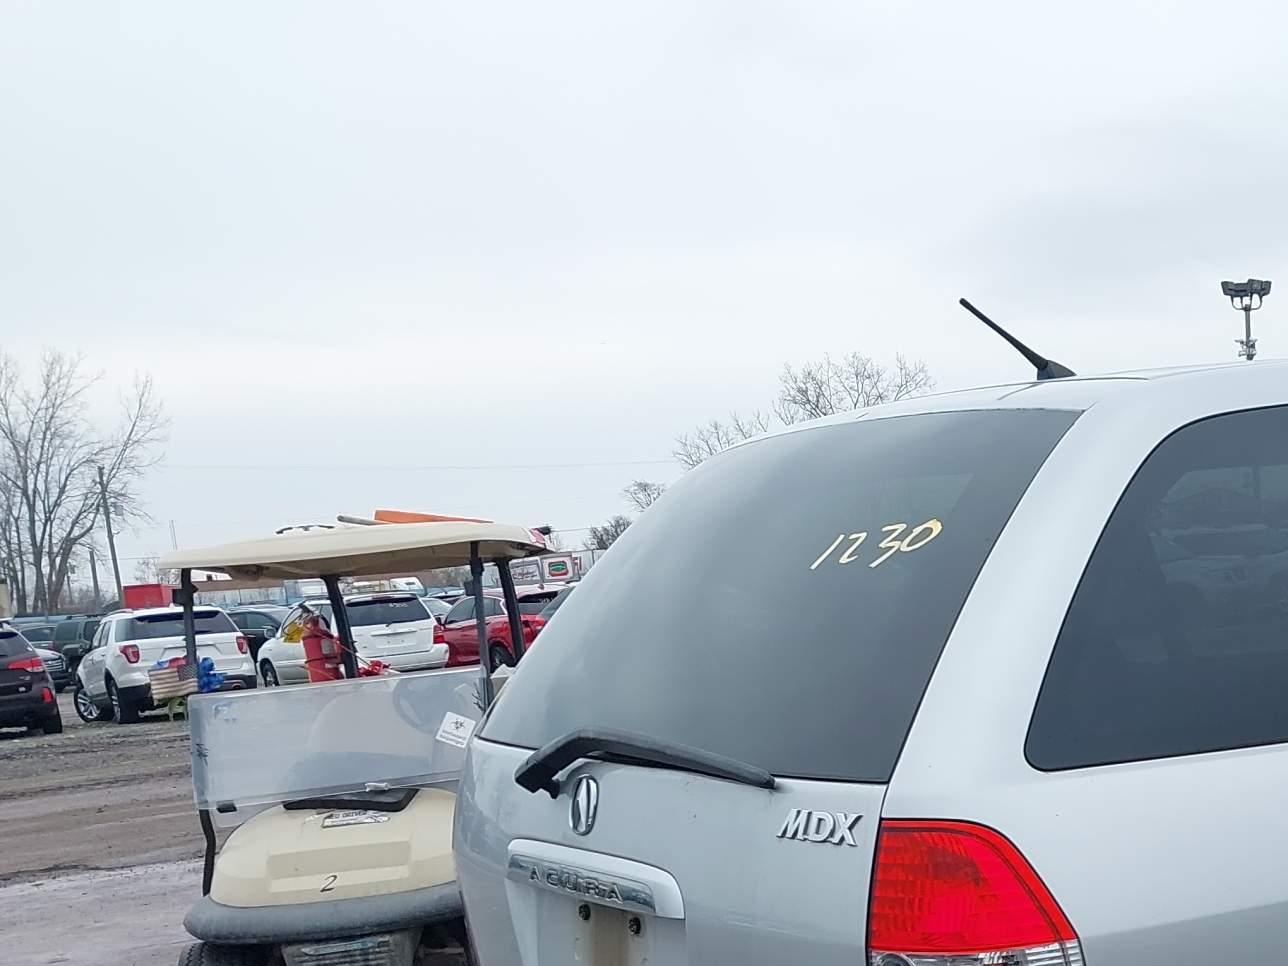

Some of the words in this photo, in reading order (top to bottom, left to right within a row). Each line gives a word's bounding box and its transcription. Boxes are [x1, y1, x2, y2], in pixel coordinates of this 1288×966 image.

[809, 518, 943, 570] 1230
[776, 808, 864, 847] MDX
[320, 874, 338, 893] 2
[528, 865, 624, 904] ACURA
